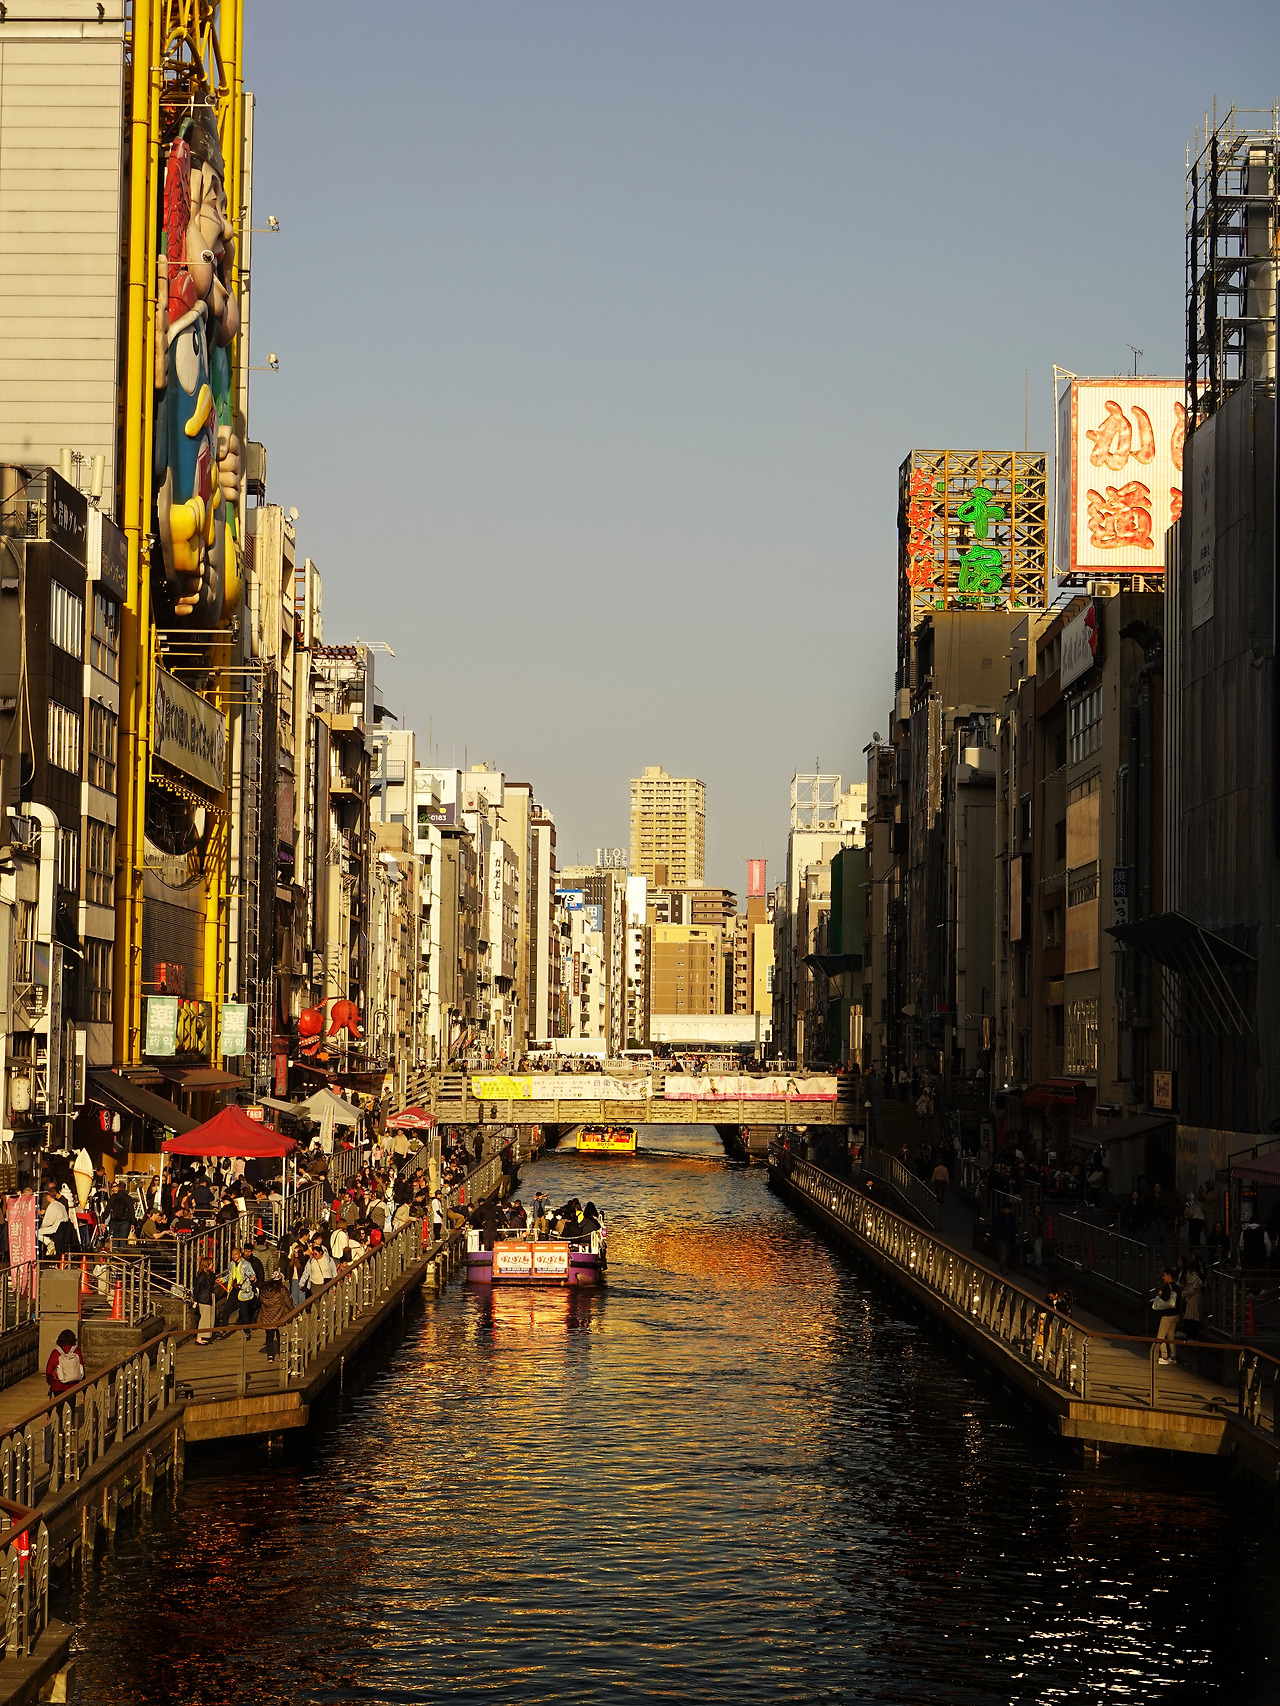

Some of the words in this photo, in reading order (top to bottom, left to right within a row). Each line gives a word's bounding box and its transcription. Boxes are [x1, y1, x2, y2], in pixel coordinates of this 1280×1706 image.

[1086, 401, 1185, 470] か
[906, 468, 935, 588] お好み焼
[1086, 480, 1184, 550] 道
[957, 487, 1005, 593] 千房
[957, 596, 1002, 604] CHIBO
[1114, 870, 1127, 896] 焼肉
[149, 1004, 174, 1028] 薬
[223, 1010, 245, 1031] 薬
